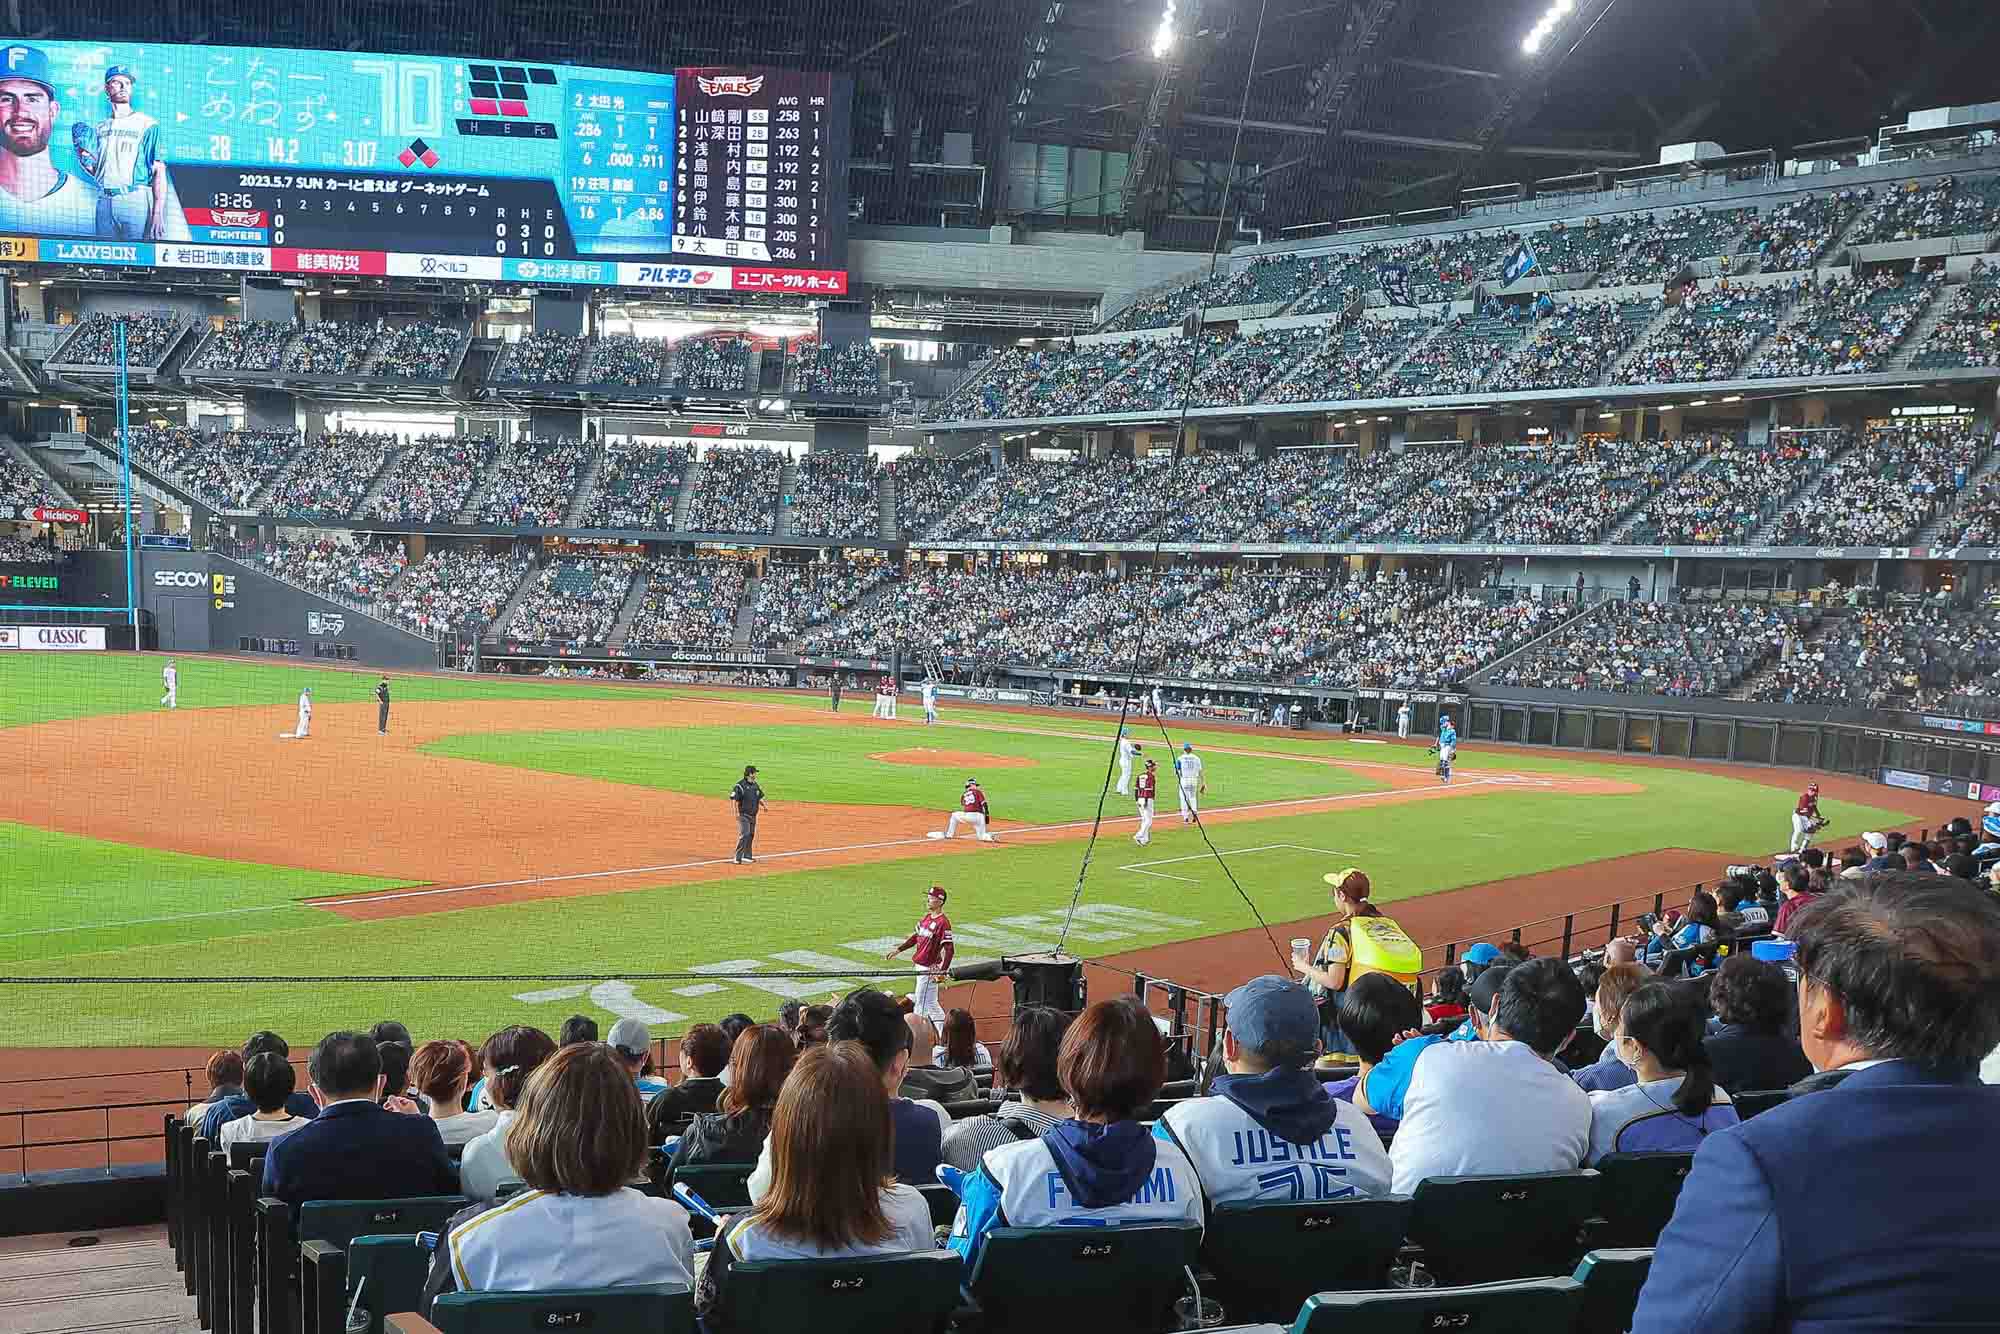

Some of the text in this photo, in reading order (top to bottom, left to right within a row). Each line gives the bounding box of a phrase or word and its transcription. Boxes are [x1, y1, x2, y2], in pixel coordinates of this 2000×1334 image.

[709, 82, 751, 94] EAGLES
[778, 97, 825, 105] AVG HR
[680, 109, 686, 122] 1
[776, 110, 800, 122] .258
[814, 111, 819, 122] 1
[470, 121, 478, 132] H
[504, 123, 511, 133] E
[574, 122, 601, 137] .286
[649, 127, 656, 140] 1
[678, 126, 687, 138] 2
[776, 128, 799, 139] .263
[814, 128, 819, 140] 1
[209, 136, 231, 160] 28
[268, 138, 299, 163] 14.2
[343, 141, 377, 166] 3.07
[678, 142, 687, 154] 3
[775, 145, 799, 157] .192
[811, 146, 819, 157] 4
[583, 152, 664, 168] 6 .000 .911
[677, 158, 687, 170] 4
[774, 162, 799, 174] .192
[811, 163, 819, 175] 2
[240, 175, 293, 188] 2023.5.7
[296, 177, 322, 190] SUN
[401, 181, 490, 197] グーネットゲーム
[572, 177, 585, 190] 19
[678, 174, 686, 186] 5
[774, 179, 797, 191] .291
[811, 181, 819, 192] 2
[213, 193, 252, 208] 13:26
[678, 190, 686, 202] 6
[774, 197, 797, 208] .300
[812, 198, 817, 209] 1
[300, 200, 307, 210] 2
[324, 201, 331, 210] 3
[347, 202, 355, 212] 4
[372, 203, 379, 212] 5
[396, 204, 403, 213] 6
[420, 204, 428, 214] 7
[444, 205, 451, 215] 8
[469, 206, 476, 216] 9
[497, 208, 505, 218] R
[521, 209, 530, 219] H
[546, 210, 553, 220] E
[580, 205, 594, 219] 16
[638, 208, 664, 221] 3.86
[677, 206, 686, 218] 7
[773, 214, 797, 225] .300
[810, 216, 818, 227] 2
[275, 215, 284, 227] 0
[496, 223, 506, 237] 0
[520, 224, 530, 237] 3
[544, 225, 554, 238] 0
[677, 223, 685, 235] 8
[773, 230, 797, 242] .205
[811, 233, 816, 244] 1
[209, 230, 554, 255] FIGHTERS 0 0 1 0
[677, 239, 685, 250] 9
[773, 248, 796, 259] .286
[810, 250, 815, 261] 1
[57, 244, 137, 260] LAWSON
[177, 249, 265, 266] 岩田地崎建設
[297, 253, 360, 271] 能美防災
[438, 262, 468, 273] ベルコ
[638, 267, 692, 284] アルキタ
[738, 273, 839, 289] ユニバーサル ホーム
[38, 629, 88, 644] CLASSIC
[672, 650, 712, 661] docomo
